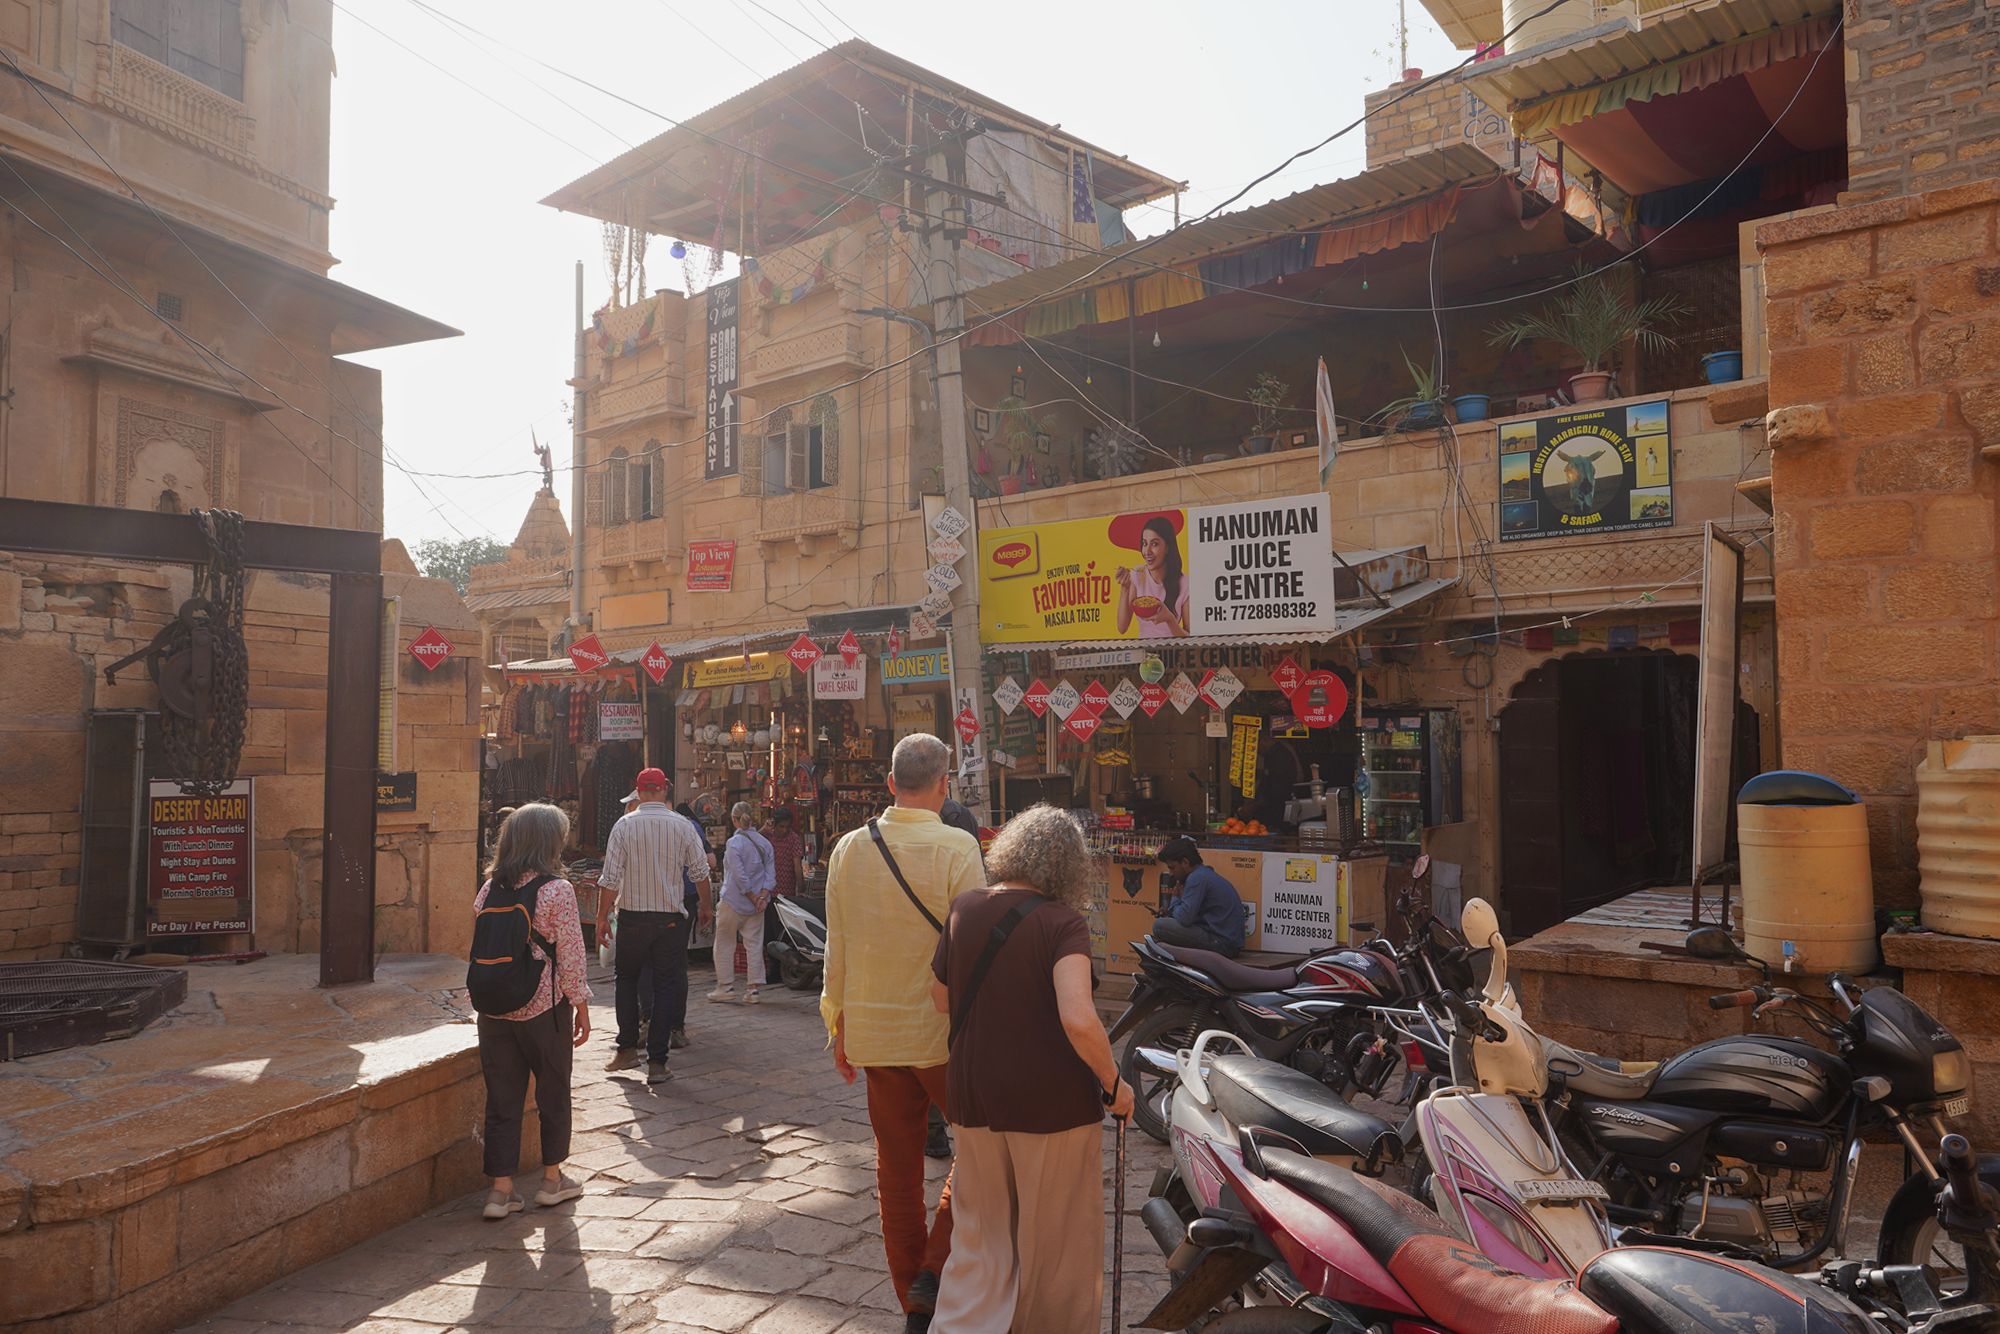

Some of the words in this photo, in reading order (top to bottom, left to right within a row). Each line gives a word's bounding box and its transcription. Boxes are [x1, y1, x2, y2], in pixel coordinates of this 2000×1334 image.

[708, 332, 718, 471] RESTAURANT
[1557, 416, 1572, 424] FREE
[1573, 412, 1606, 422] GUIDANCE
[1533, 446, 1552, 474] HOSTEL
[1550, 425, 1599, 447] MARRIGOLD
[1599, 426, 1623, 446] HOME
[1618, 444, 1634, 464] STAY
[1199, 506, 1318, 543] HANUMAN
[1560, 514, 1569, 524] &
[1570, 512, 1602, 526] SAFARI
[691, 549, 706, 564] Top
[709, 548, 730, 560] View
[997, 547, 1028, 561] Maggi
[1224, 540, 1292, 571] JUICE
[934, 564, 955, 580] COLD
[1065, 564, 1081, 576] YOUR
[1214, 571, 1304, 601] CENTRE
[1044, 610, 1075, 628] MASALA
[1205, 606, 1227, 622] PH:
[1230, 602, 1317, 620] 7728898382
[414, 642, 448, 655] कॉफी
[648, 655, 666, 669] मैगी
[884, 654, 936, 678] MONEY
[1059, 656, 1092, 668] FRESH
[1096, 652, 1132, 665] JUICE
[728, 662, 765, 674] Handaft's
[837, 678, 858, 693] SAFARI
[1280, 678, 1297, 689] पानी
[1114, 694, 1138, 708] SODA
[600, 704, 641, 717] RESTAURANT
[1071, 719, 1095, 729] चाय
[154, 800, 200, 822] DESERT
[204, 799, 246, 820] SAFARI
[152, 826, 186, 836] Touristic
[188, 825, 194, 834] &
[196, 824, 245, 834] NonTouristic
[164, 841, 181, 852] With
[183, 840, 206, 851] Lunch
[208, 839, 234, 850] Dinner
[160, 857, 181, 869] Night
[183, 857, 200, 868] Stay
[202, 857, 210, 865] at
[212, 856, 236, 865] Dunes
[169, 873, 186, 882] With
[188, 872, 210, 883] Camp
[212, 871, 227, 880] Fire
[196, 886, 234, 898] Breakfast
[1274, 892, 1322, 906] HANUMAN
[1267, 908, 1292, 920] JUICE
[1295, 909, 1330, 923] CENTER
[151, 923, 167, 932] Per
[169, 922, 187, 933] Day
[195, 921, 211, 931] Per
[213, 920, 246, 930] Person
[1281, 924, 1332, 939] 7728898382
[1769, 1054, 1808, 1068] Hero
[1592, 1107, 1644, 1121] Splendor
